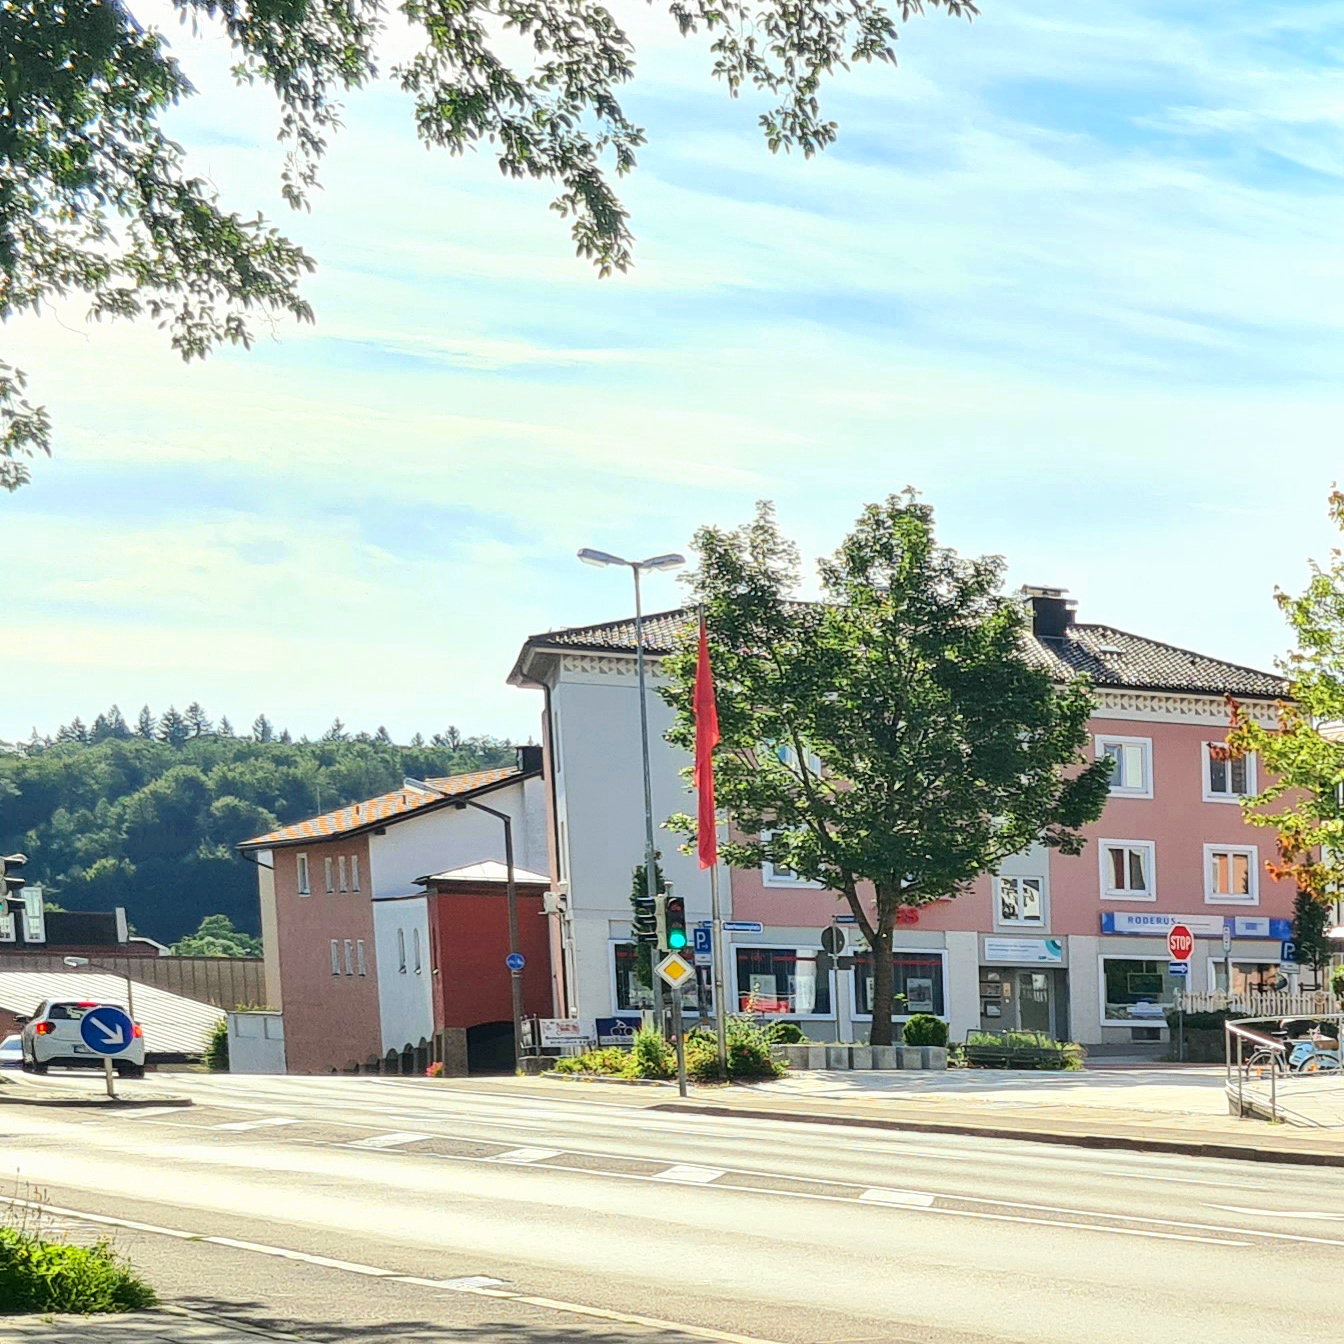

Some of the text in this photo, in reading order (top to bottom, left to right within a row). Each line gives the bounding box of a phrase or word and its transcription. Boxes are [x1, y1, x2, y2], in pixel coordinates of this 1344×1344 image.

[1128, 916, 1176, 926] RODERUS
[696, 931, 706, 949] P
[1170, 935, 1191, 951] STOP
[1284, 942, 1296, 959] P
